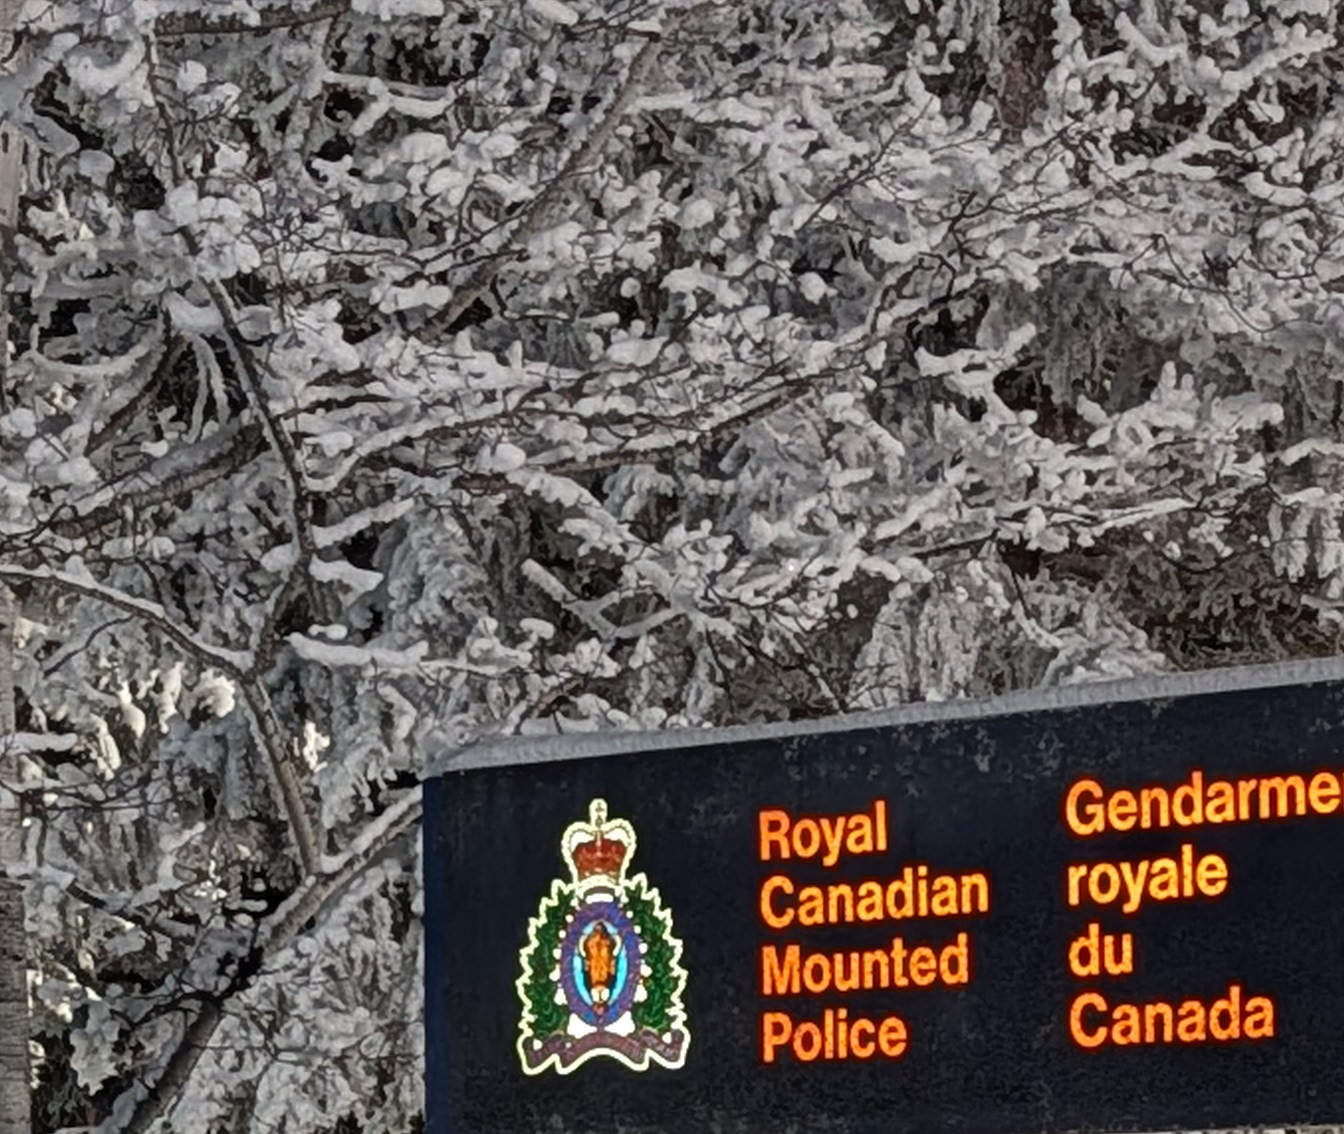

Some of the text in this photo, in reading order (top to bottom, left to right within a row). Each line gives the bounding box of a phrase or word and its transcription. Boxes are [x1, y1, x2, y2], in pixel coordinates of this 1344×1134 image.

[758, 799, 888, 867] Royal
[759, 864, 989, 929] Canadian
[1067, 843, 1229, 914] royale
[761, 932, 969, 996] Mounted
[1068, 922, 1134, 978] du
[762, 1007, 908, 1063] Police
[1069, 985, 1275, 1048] Canada
